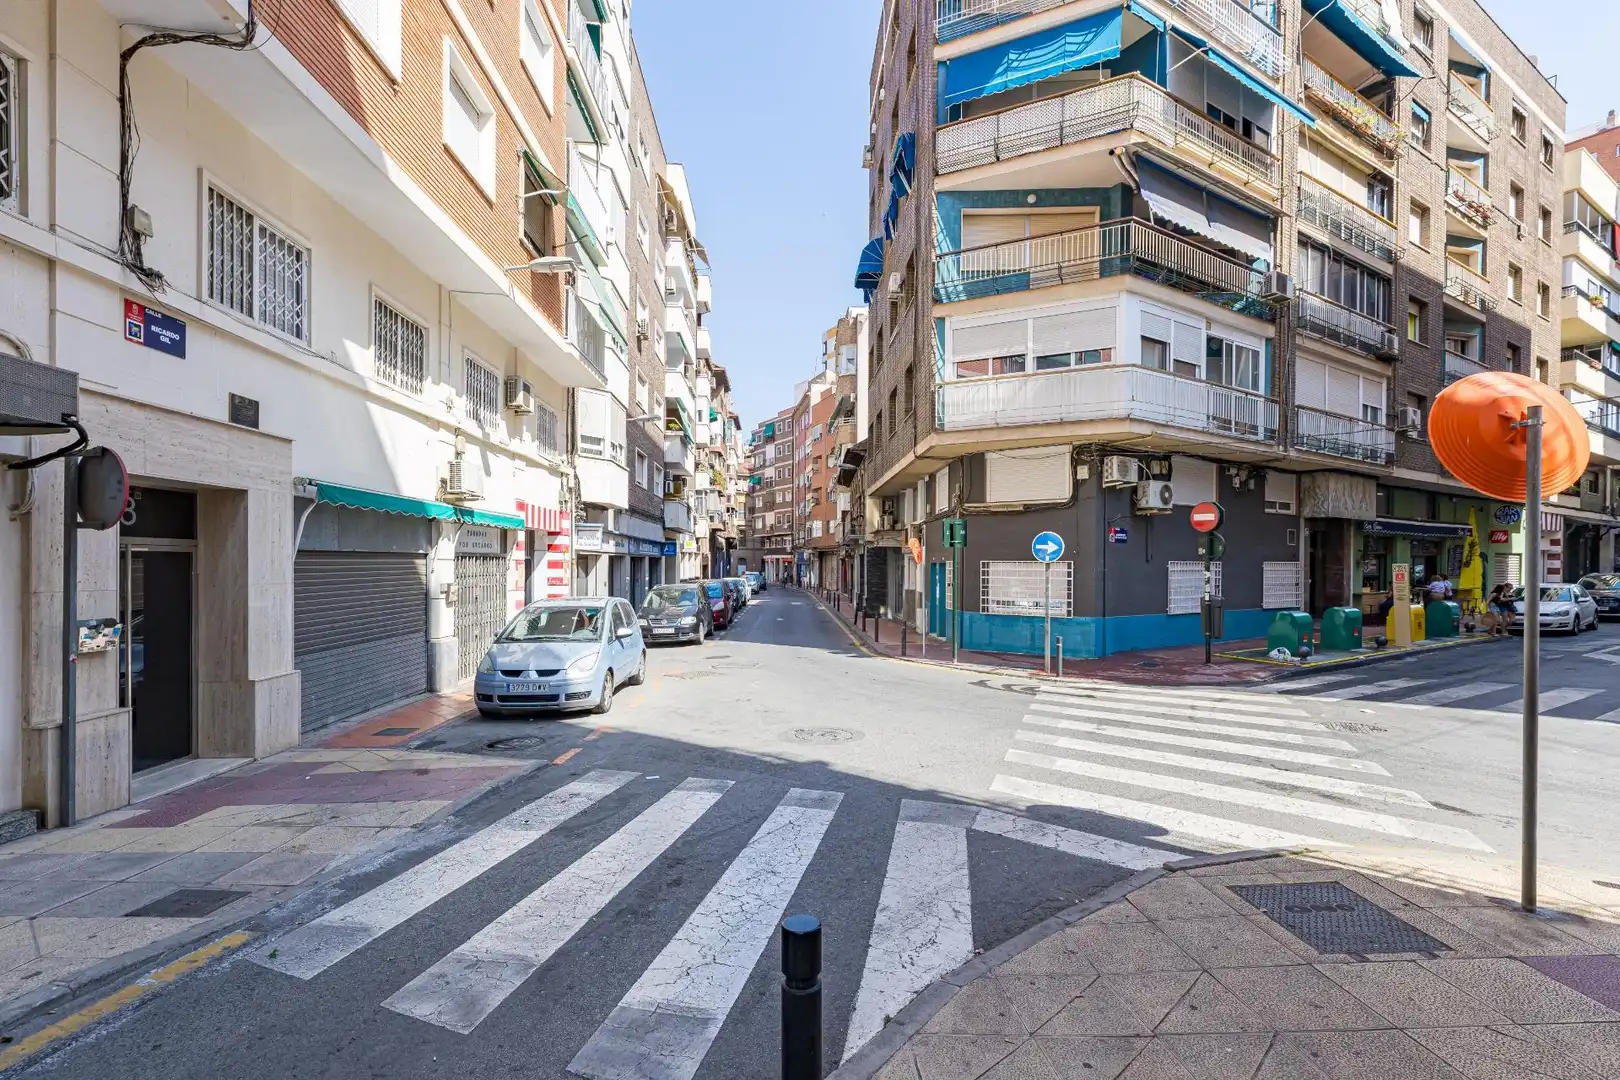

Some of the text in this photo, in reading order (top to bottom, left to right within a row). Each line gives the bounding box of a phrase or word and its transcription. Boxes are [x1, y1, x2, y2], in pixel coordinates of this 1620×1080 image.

[145, 308, 162, 319] CALLE
[151, 325, 180, 341] RICARDO
[160, 335, 171, 345] GIL
[1496, 506, 1517, 516] BAR
[1491, 531, 1508, 543] illy
